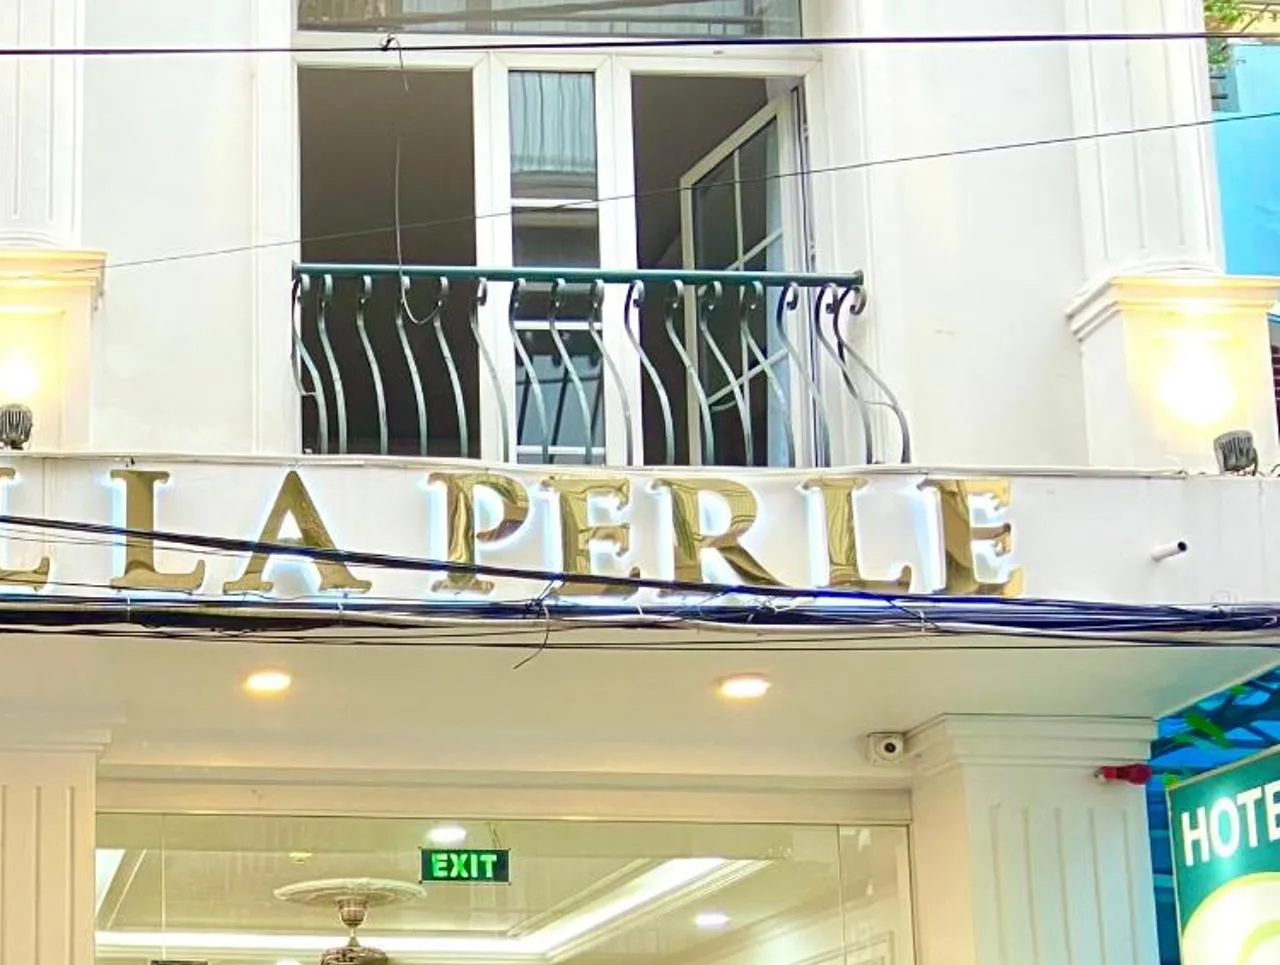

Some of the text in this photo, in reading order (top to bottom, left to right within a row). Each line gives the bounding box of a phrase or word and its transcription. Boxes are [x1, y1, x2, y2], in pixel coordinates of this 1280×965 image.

[110, 468, 373, 595] LA
[427, 472, 1025, 600] PERLE
[431, 852, 498, 878] EXIT
